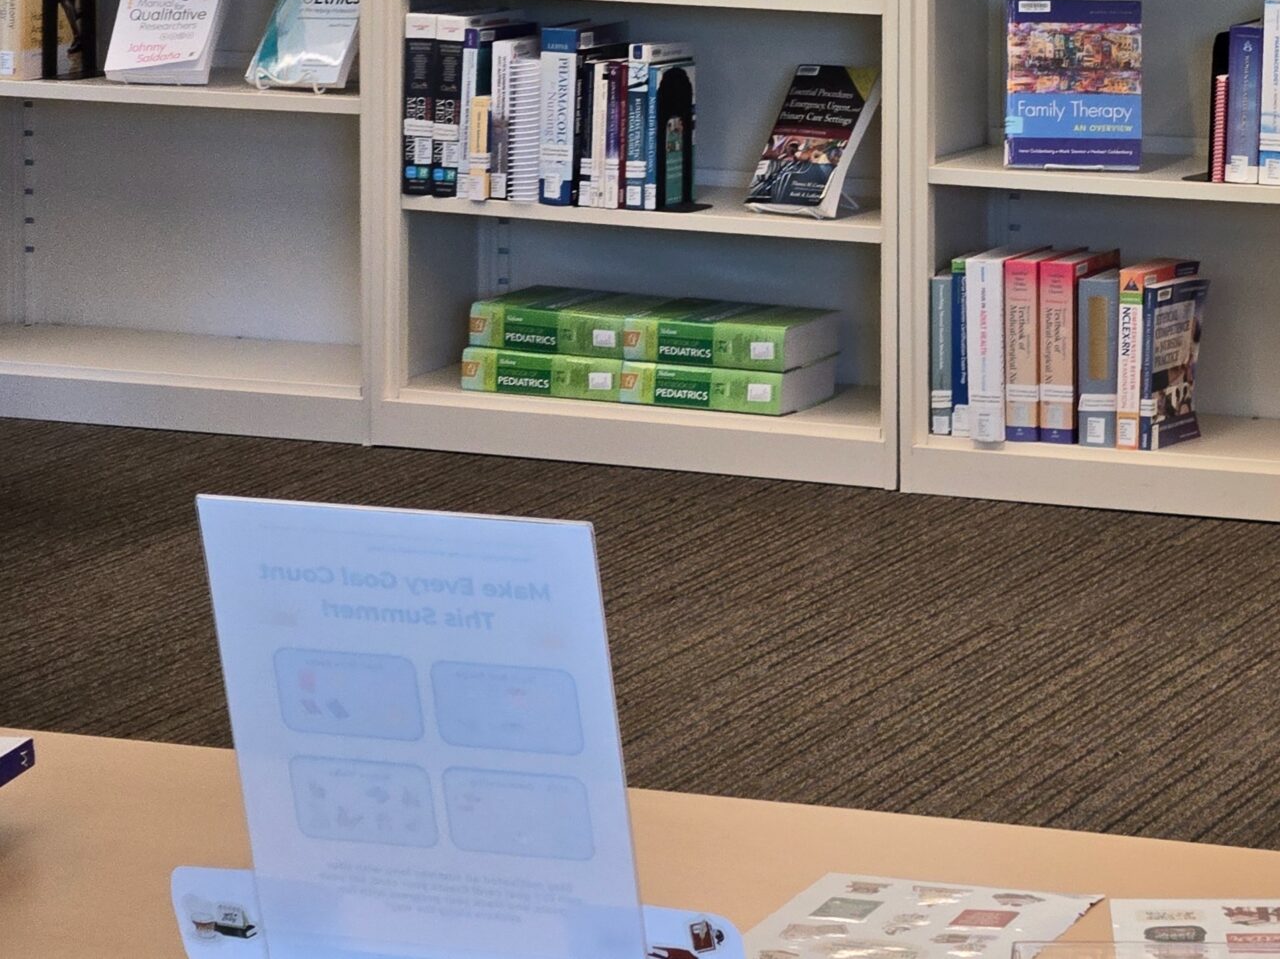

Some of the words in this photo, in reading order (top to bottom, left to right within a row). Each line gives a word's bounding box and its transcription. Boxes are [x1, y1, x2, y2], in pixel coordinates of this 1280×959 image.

[174, 1, 185, 10] for
[129, 7, 208, 24] Qualitative
[139, 20, 198, 31] Researchers
[127, 42, 168, 55] Johnny
[1018, 100, 1065, 122] Family
[1070, 101, 1132, 122] Therapy
[779, 112, 806, 121] Primary
[806, 113, 823, 122] Care
[824, 114, 853, 126] Settings
[1054, 308, 1062, 343] Textbook
[1121, 307, 1131, 356] NCLEX-RN
[505, 332, 556, 345] PEDIATRICS
[1008, 304, 1018, 371] Medical-Surgical
[1044, 307, 1053, 372] Medical-Surgical
[659, 346, 712, 358] PEDIATRICS
[1018, 342, 1025, 351] of
[1054, 345, 1061, 353] of
[497, 376, 550, 388] PEDIATRICS
[655, 388, 709, 401] PEDIATRICS
